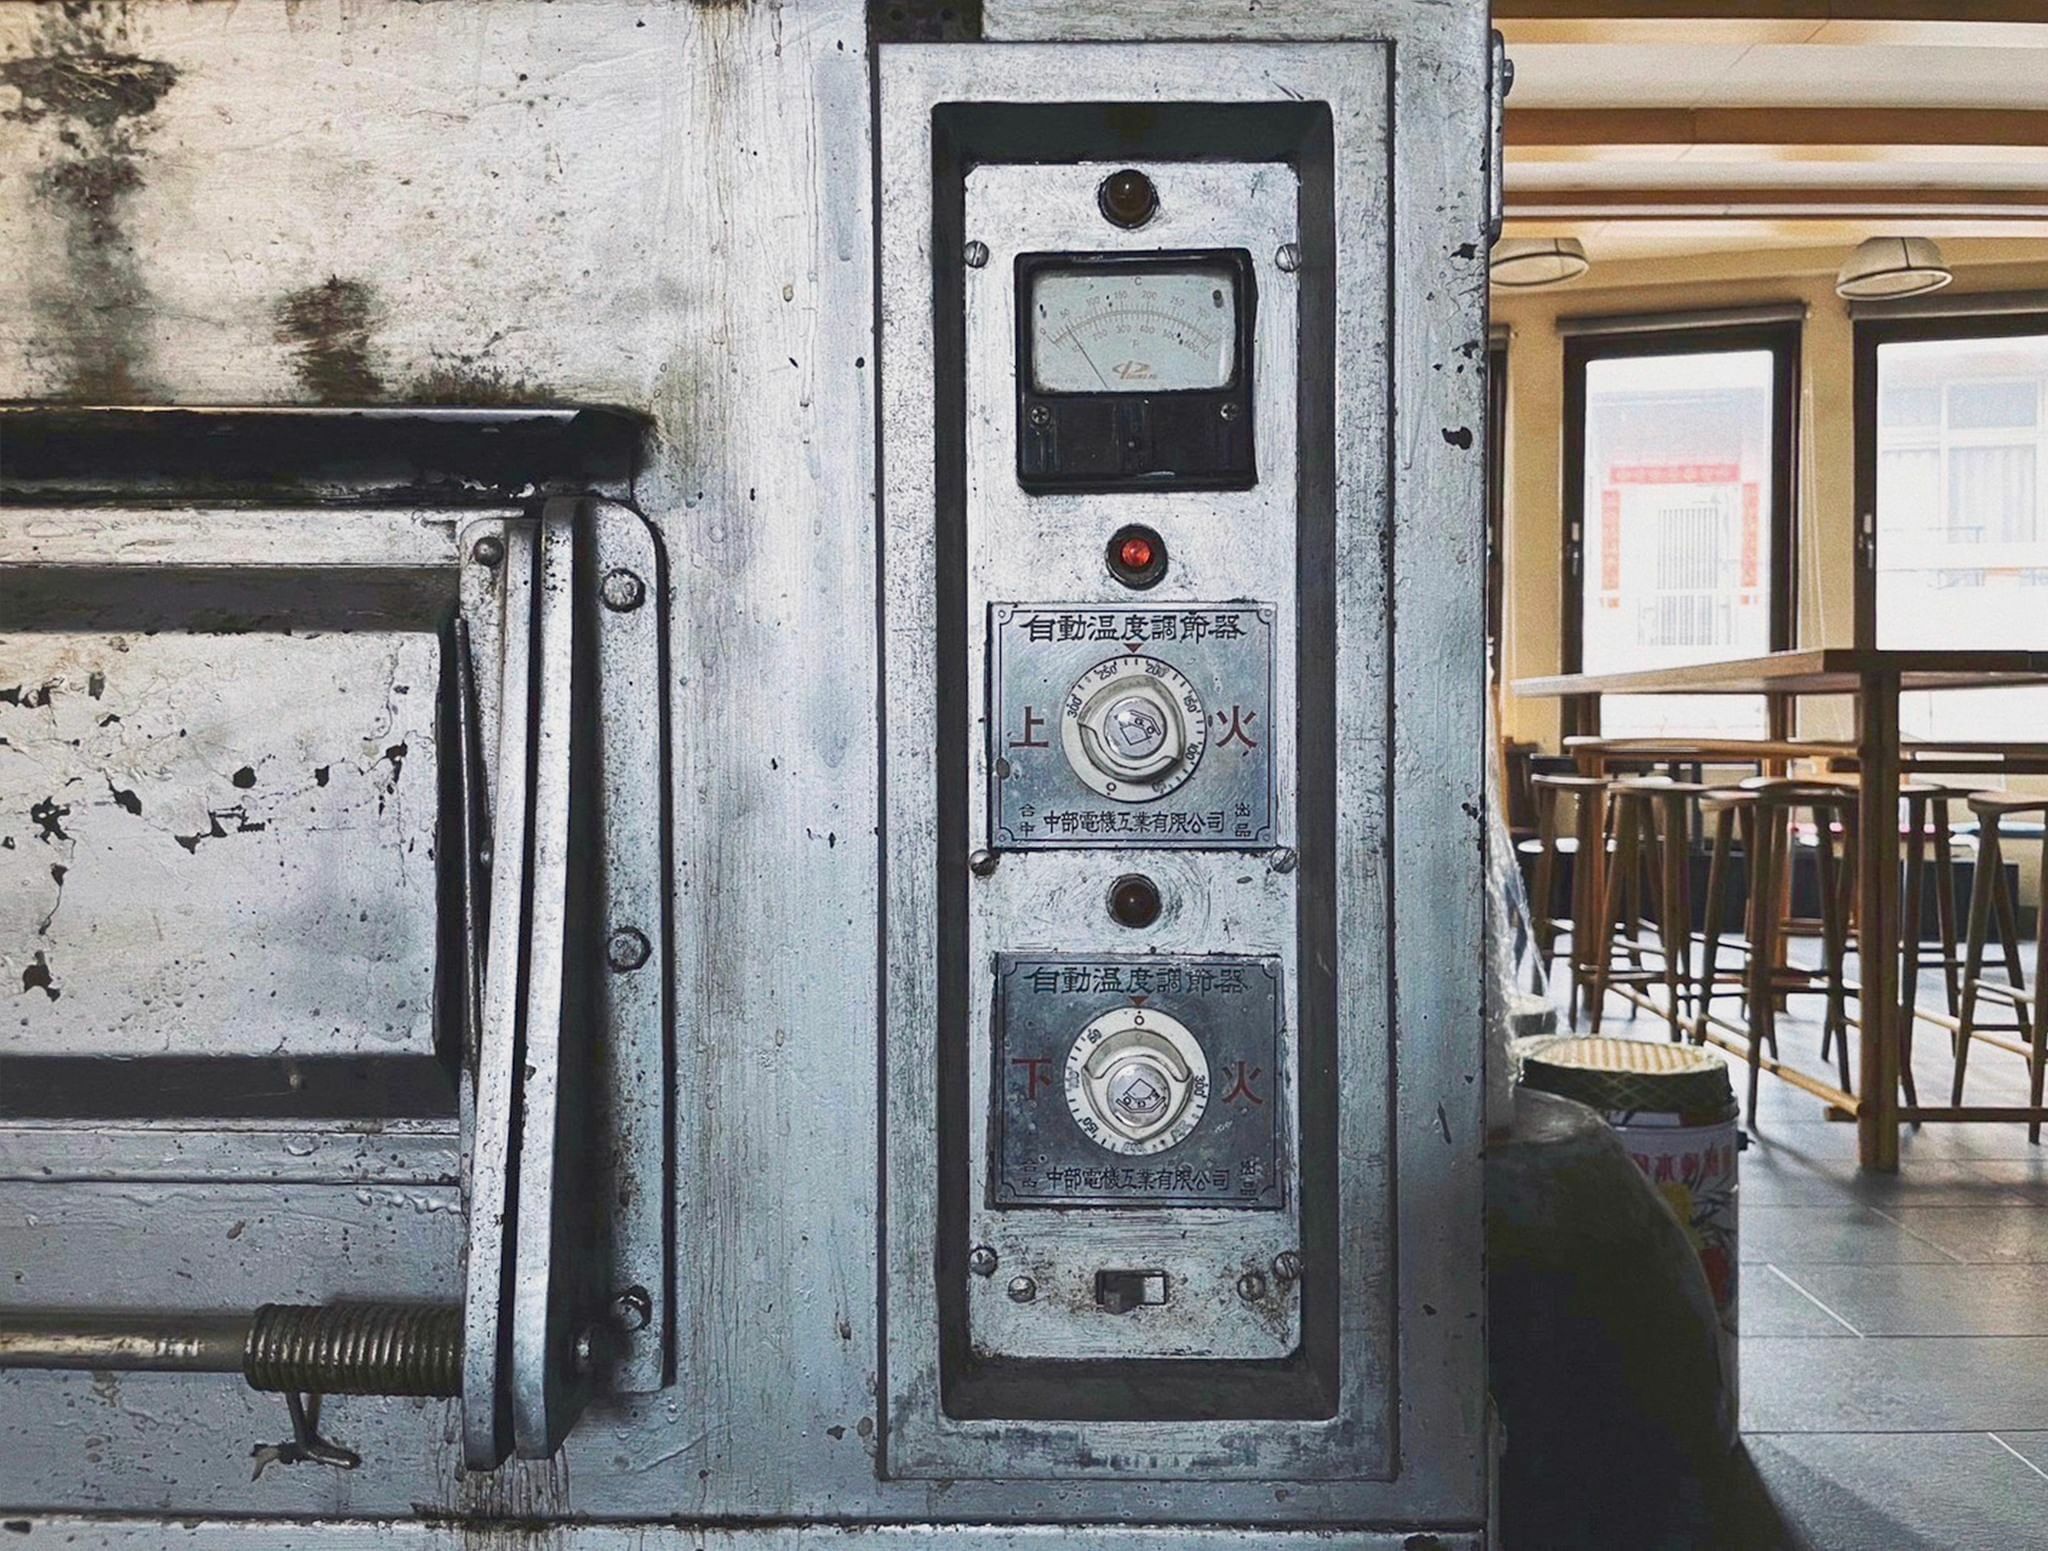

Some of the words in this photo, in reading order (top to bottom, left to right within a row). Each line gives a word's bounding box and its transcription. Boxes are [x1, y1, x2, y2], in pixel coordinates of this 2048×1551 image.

[1113, 290, 1129, 300] 150
[1141, 290, 1158, 301] 200
[1115, 325, 1132, 335] 300
[1098, 664, 1119, 681] 250
[1144, 663, 1170, 679] 200
[1066, 696, 1083, 719] 300
[1183, 694, 1198, 714] 150
[1009, 706, 1049, 748] 上
[1215, 705, 1257, 749] 火
[1185, 742, 1200, 761] 100
[1105, 782, 1117, 793] 0
[1043, 810, 1225, 834] 中部電機工業有限公司
[1134, 1015, 1145, 1026] 0
[1086, 1027, 1103, 1044] 50
[1011, 1058, 1051, 1100] 下
[1222, 1061, 1263, 1105] 火
[1193, 1074, 1207, 1097] 300
[1082, 1116, 1100, 1134] 150
